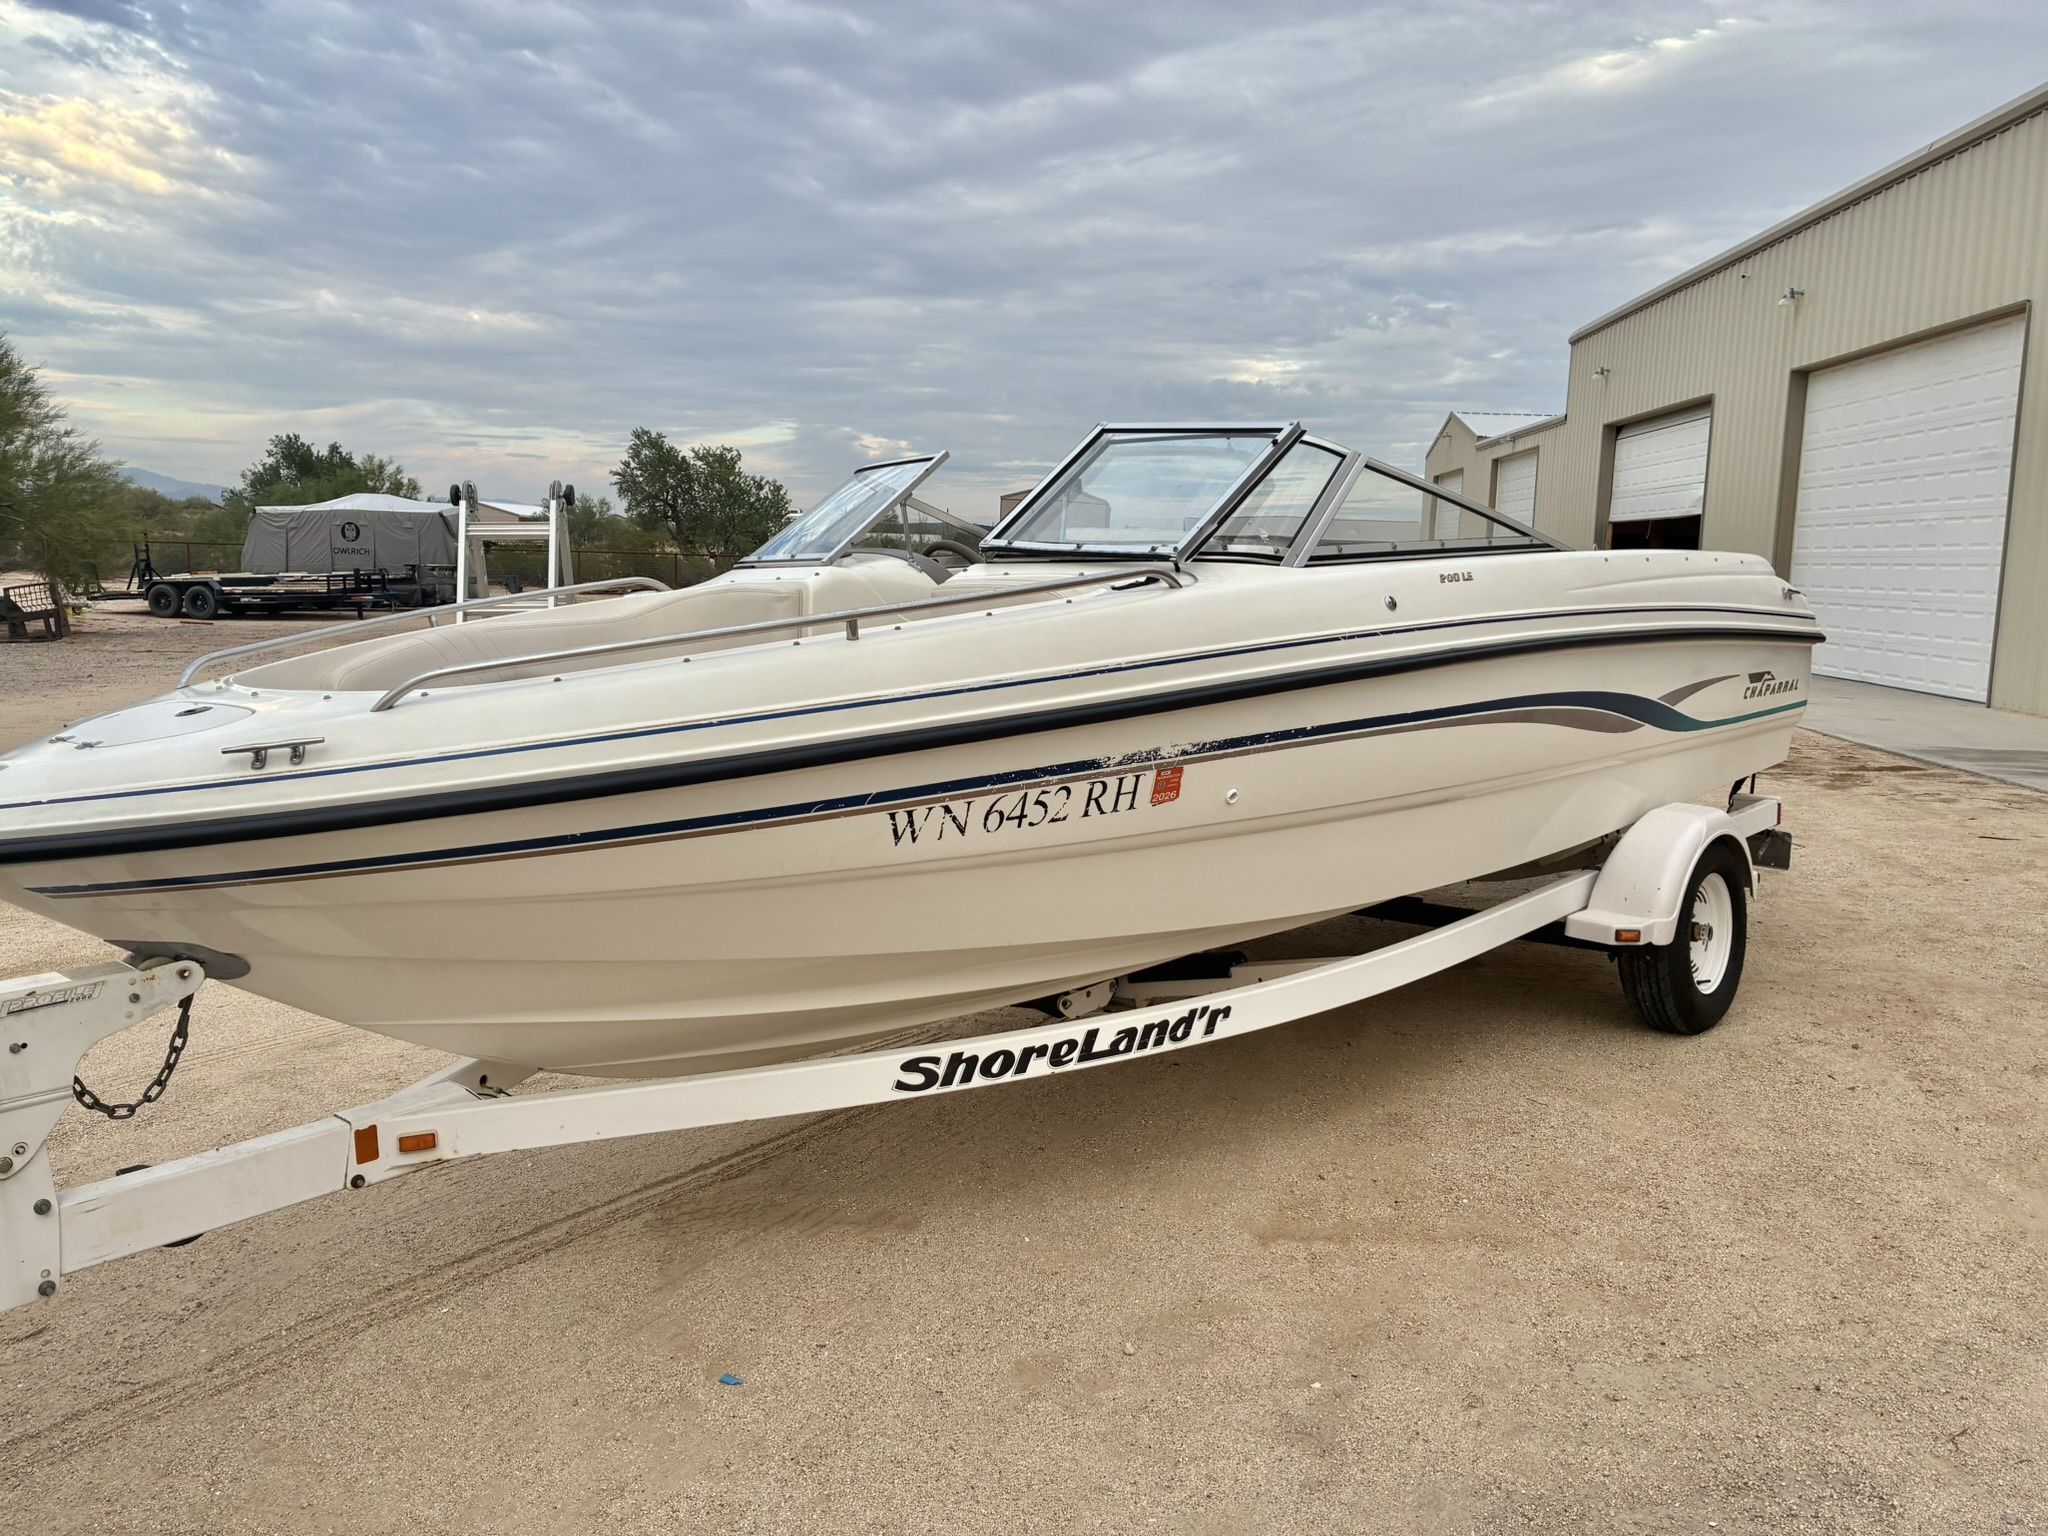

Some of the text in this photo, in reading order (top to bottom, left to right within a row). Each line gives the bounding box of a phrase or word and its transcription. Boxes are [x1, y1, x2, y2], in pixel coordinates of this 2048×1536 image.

[333, 547, 370, 556] OWLRICH
[1439, 571, 1474, 584] 200 LE
[1743, 678, 1800, 700] CHAPARRAL
[1152, 791, 1177, 802] 2026
[886, 773, 1147, 848] WN 6452 RH
[8, 984, 97, 1011] PROFILE
[892, 1005, 1233, 1093] ShoreLand'r
